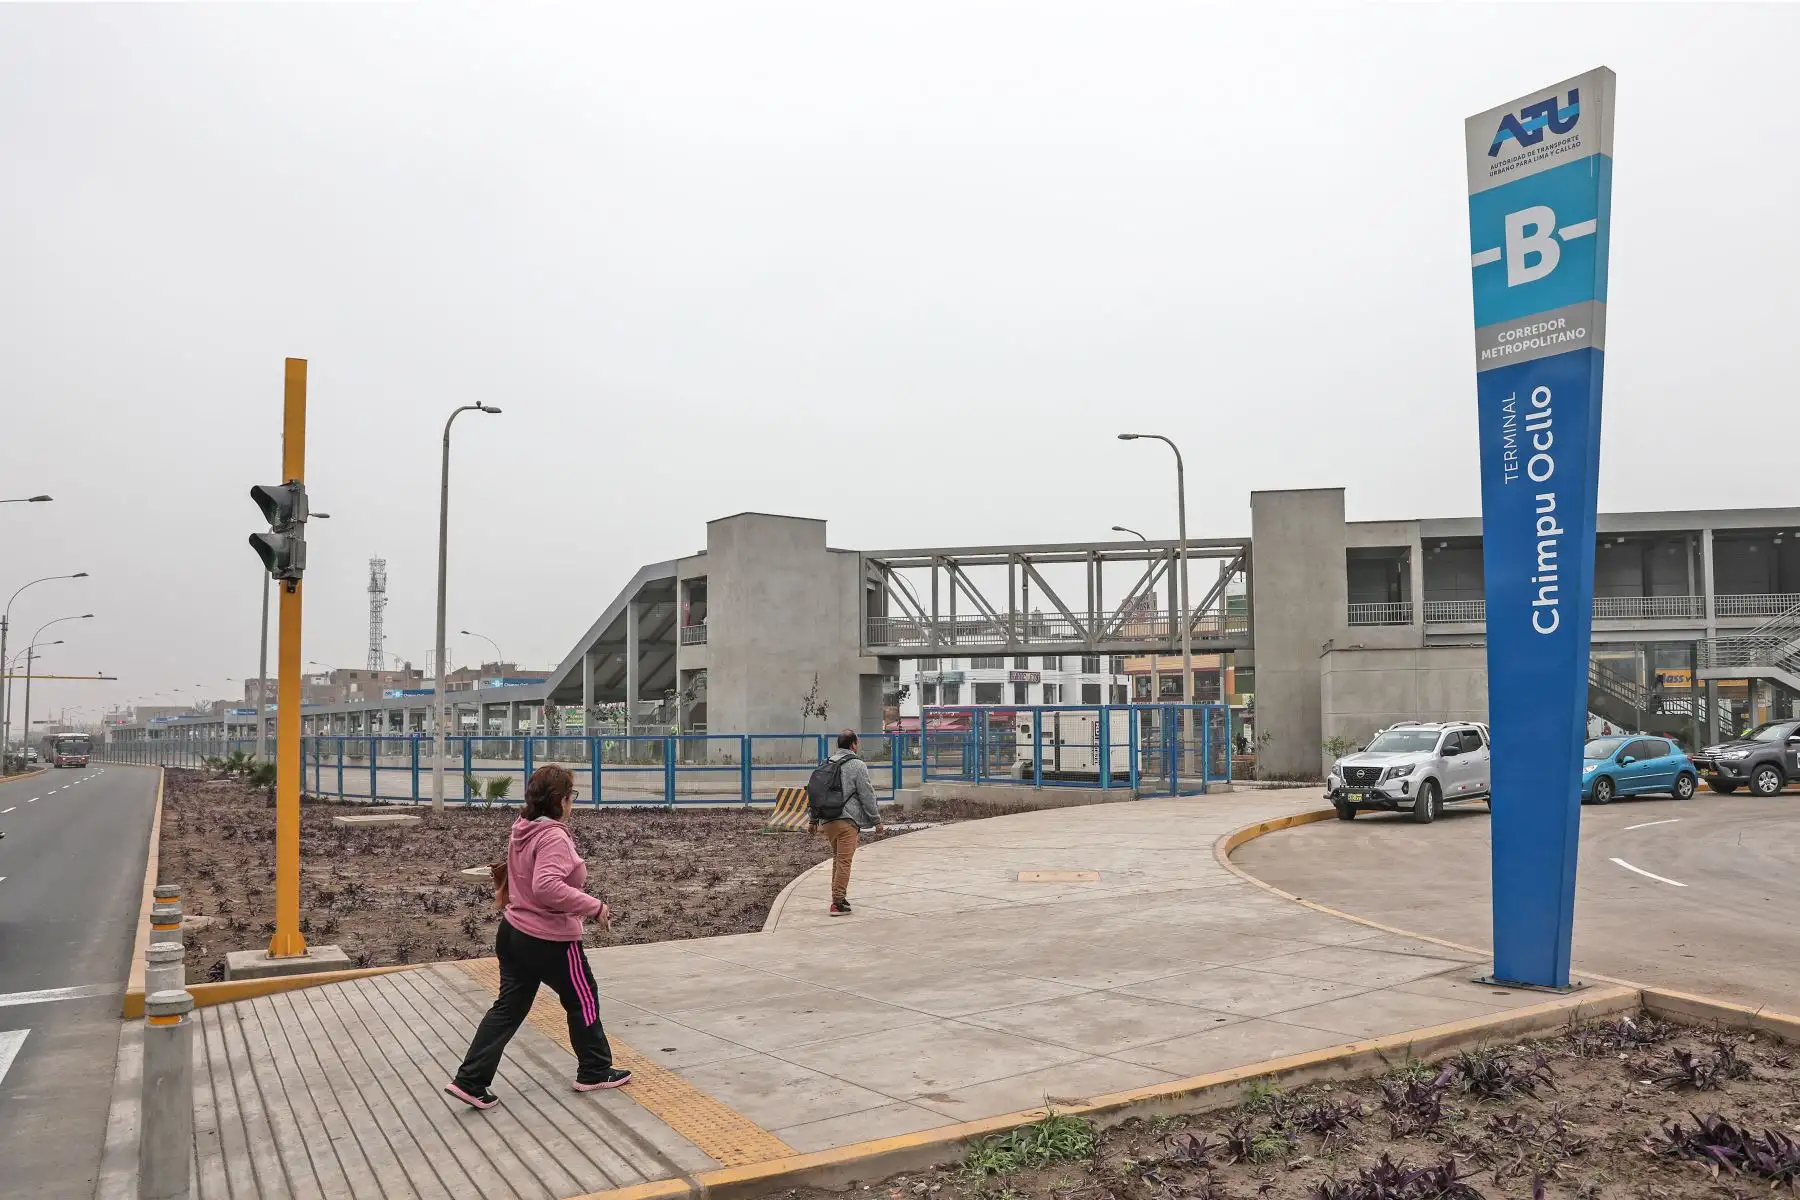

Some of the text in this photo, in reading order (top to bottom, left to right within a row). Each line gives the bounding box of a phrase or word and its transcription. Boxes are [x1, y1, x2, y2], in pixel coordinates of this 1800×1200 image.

[1487, 87, 1580, 157] ATU
[1489, 164, 1516, 177] URBANO
[1516, 158, 1532, 168] PARA
[1533, 152, 1549, 162] LIMA
[1556, 141, 1581, 155] CALLAO
[1490, 134, 1580, 170] AUTORIDAD DE TRANSPORTE
[1505, 205, 1560, 287] B
[1481, 327, 1586, 361] METROPOLITANO
[1498, 318, 1566, 342] CORREDOR
[1502, 391, 1518, 485] TERMINAL
[1525, 385, 1564, 635] Chimpu Ocllo
